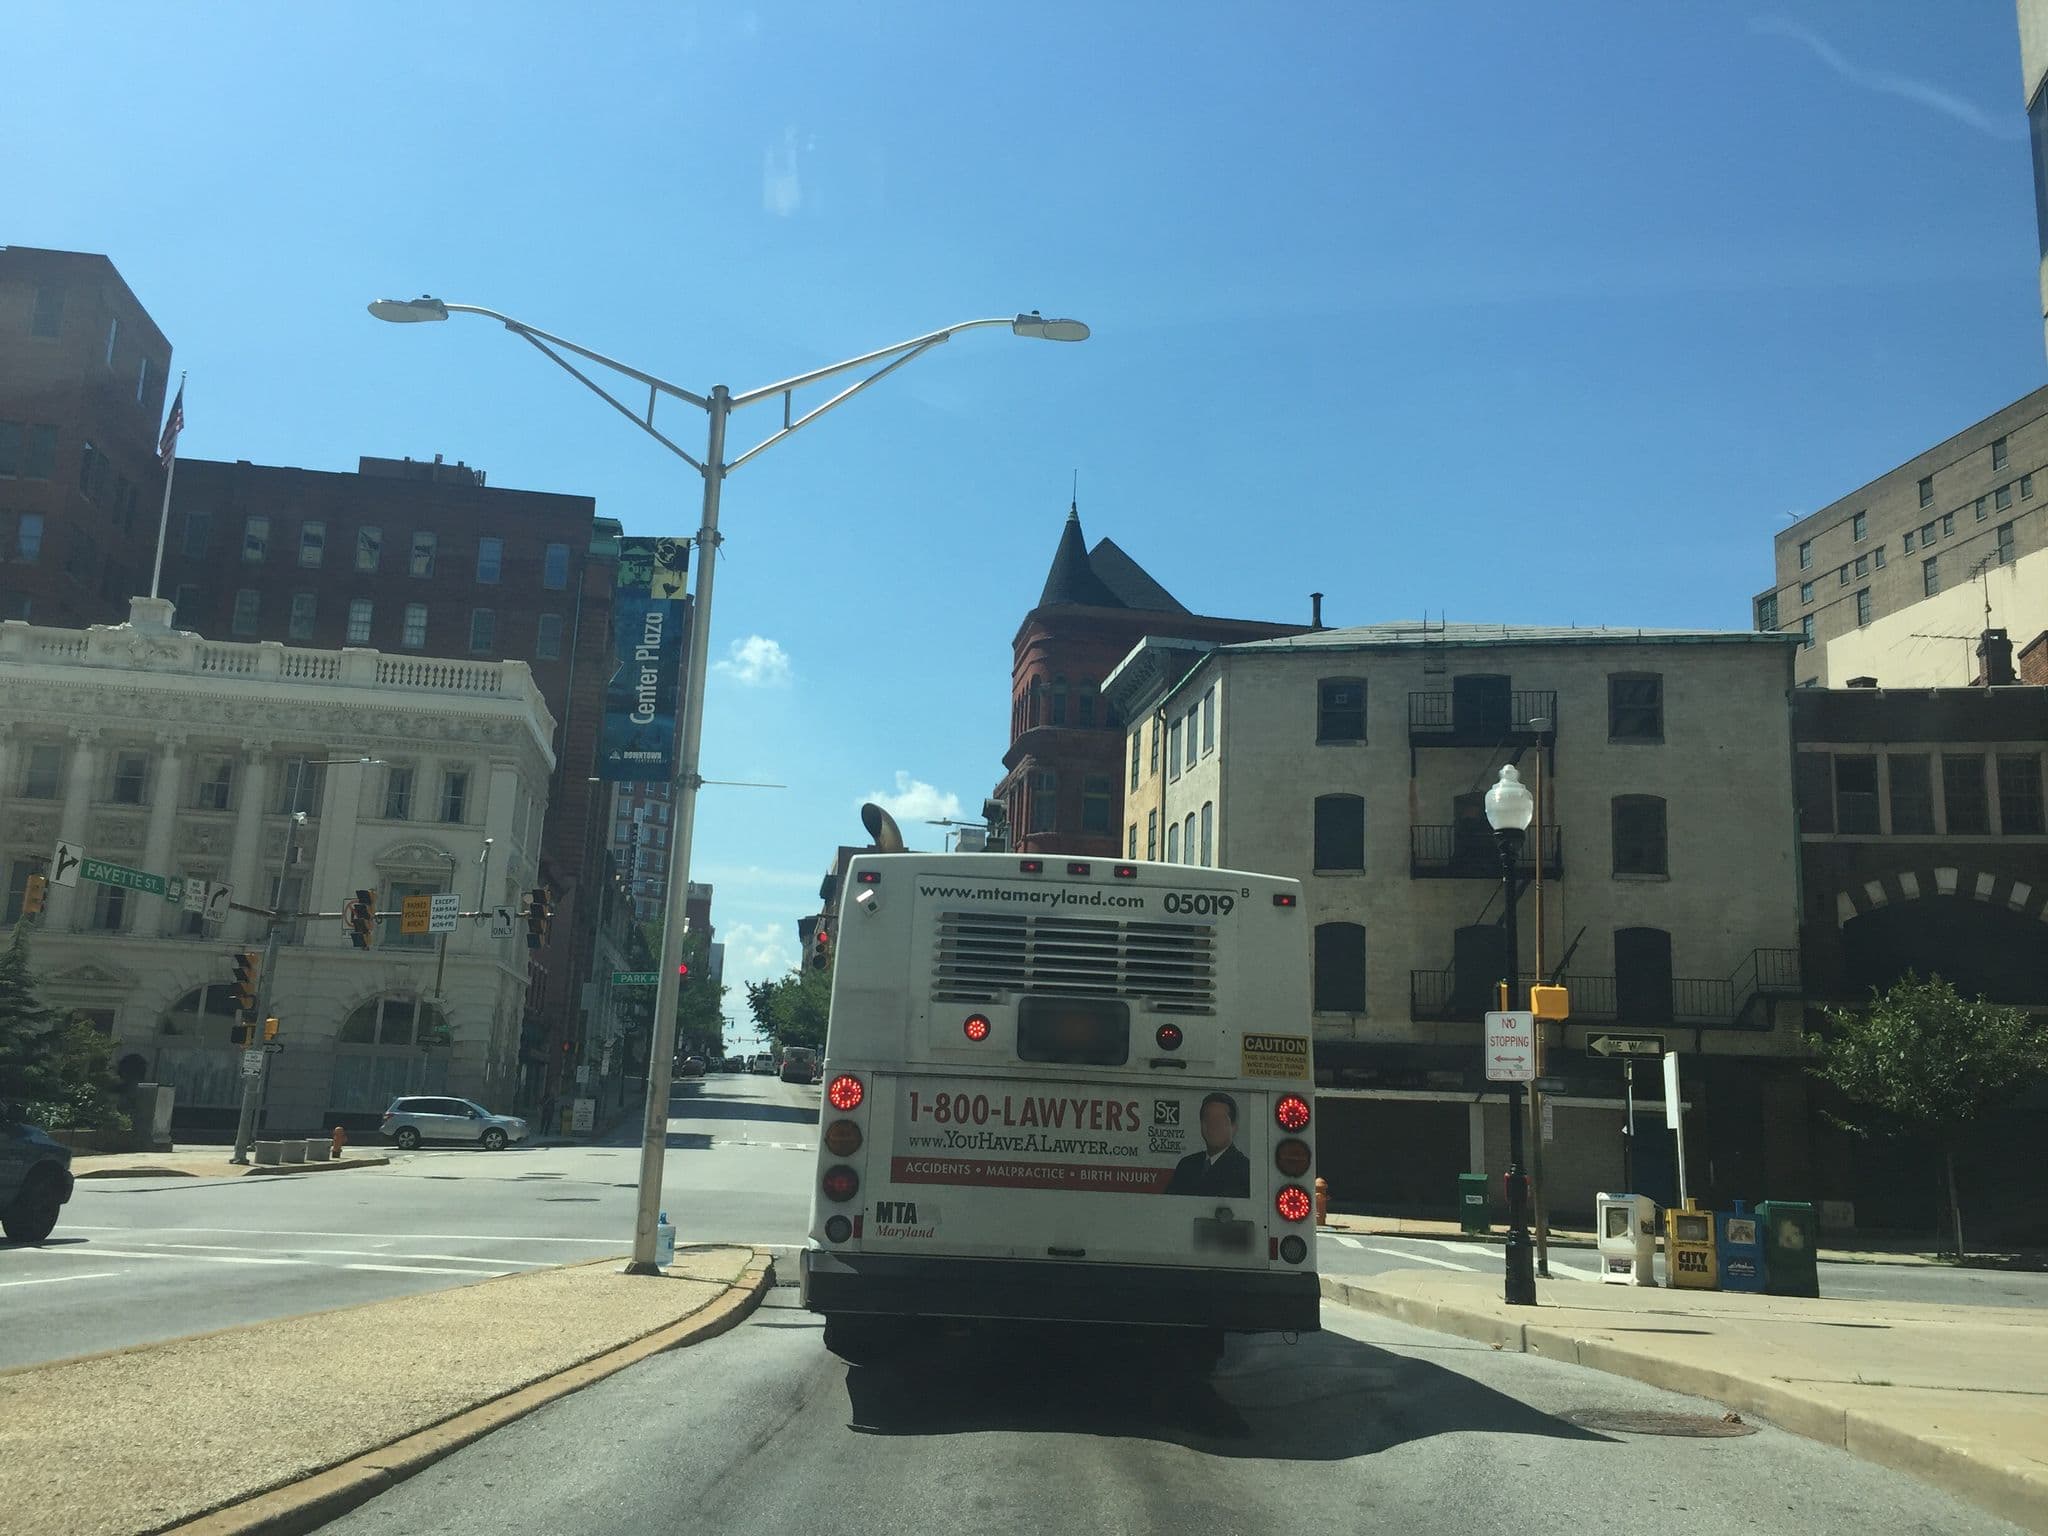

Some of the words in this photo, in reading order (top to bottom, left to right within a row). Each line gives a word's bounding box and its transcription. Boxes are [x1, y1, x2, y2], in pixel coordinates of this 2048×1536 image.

[635, 612, 663, 661] Plaza
[629, 665, 658, 725] Center
[86, 863, 142, 887] FAYETTE
[145, 877, 161, 892] ST.
[920, 886, 1144, 908] www.mtamaryland.com
[1240, 888, 1249, 898] B
[1163, 892, 1234, 915] 05019
[493, 927, 512, 936] ONLY
[620, 974, 647, 983] PARK
[1501, 1018, 1517, 1029] NO
[1245, 1037, 1306, 1052] CAUTION
[1489, 1035, 1529, 1048] STOPPING
[910, 1091, 1142, 1132] 1-800-LAWYERS
[1154, 1101, 1179, 1123] SK
[905, 1161, 971, 1175] ACCIDENTS
[985, 1165, 1065, 1179] MALPRACTICE
[1079, 1169, 1112, 1182] BIRTH
[1116, 1170, 1158, 1183] INJURY
[876, 1201, 918, 1225] MTA
[875, 1225, 935, 1240] Maryland
[1678, 1251, 1708, 1264] CITY
[1678, 1263, 1708, 1273] PAPER
